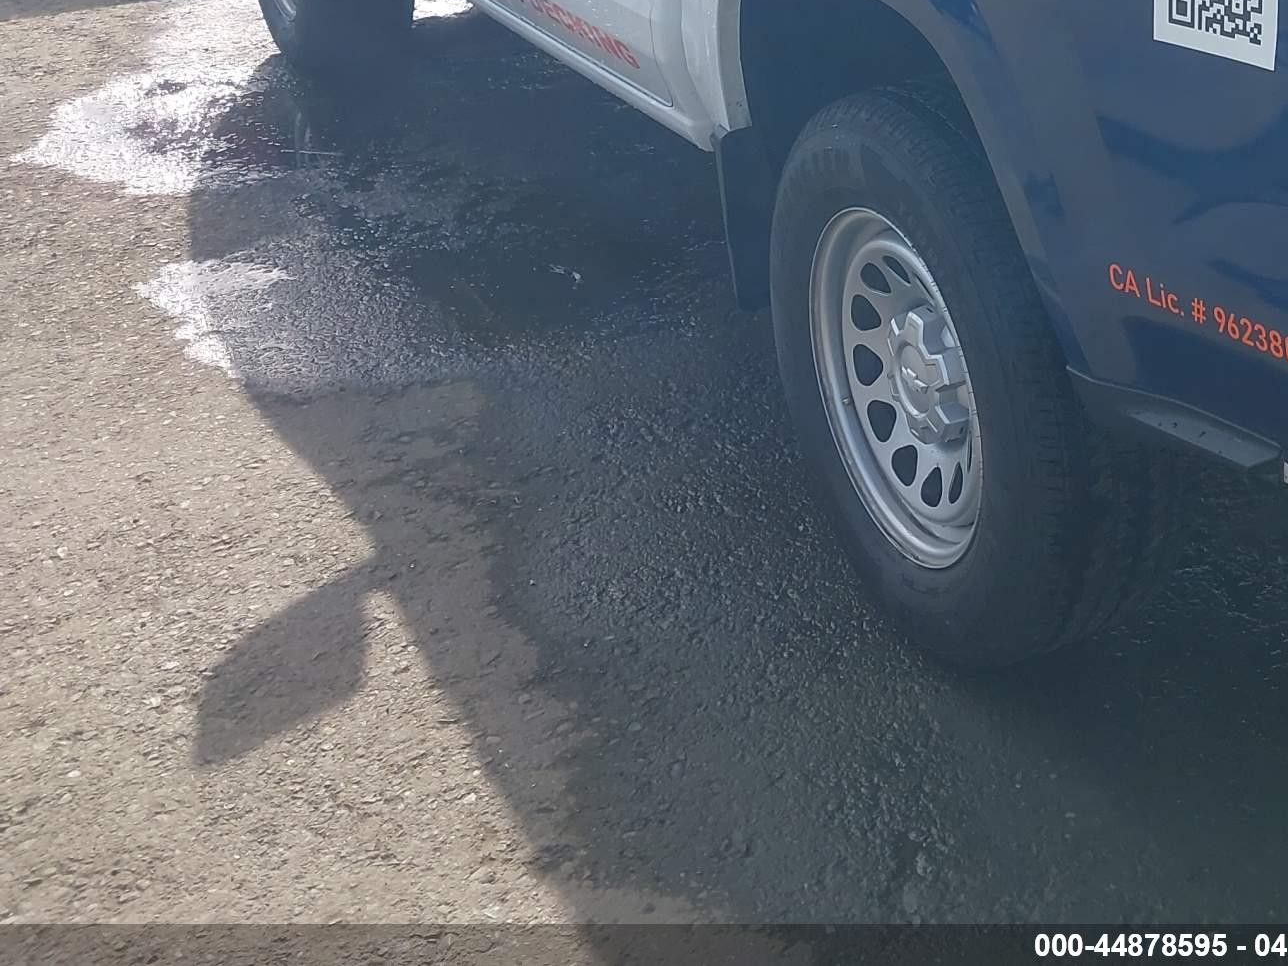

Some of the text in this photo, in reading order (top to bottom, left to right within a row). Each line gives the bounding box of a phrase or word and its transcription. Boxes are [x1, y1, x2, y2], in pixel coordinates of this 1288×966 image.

[1109, 264, 1140, 298] CA
[1146, 277, 1185, 316] Lic.
[1191, 297, 1207, 324] #
